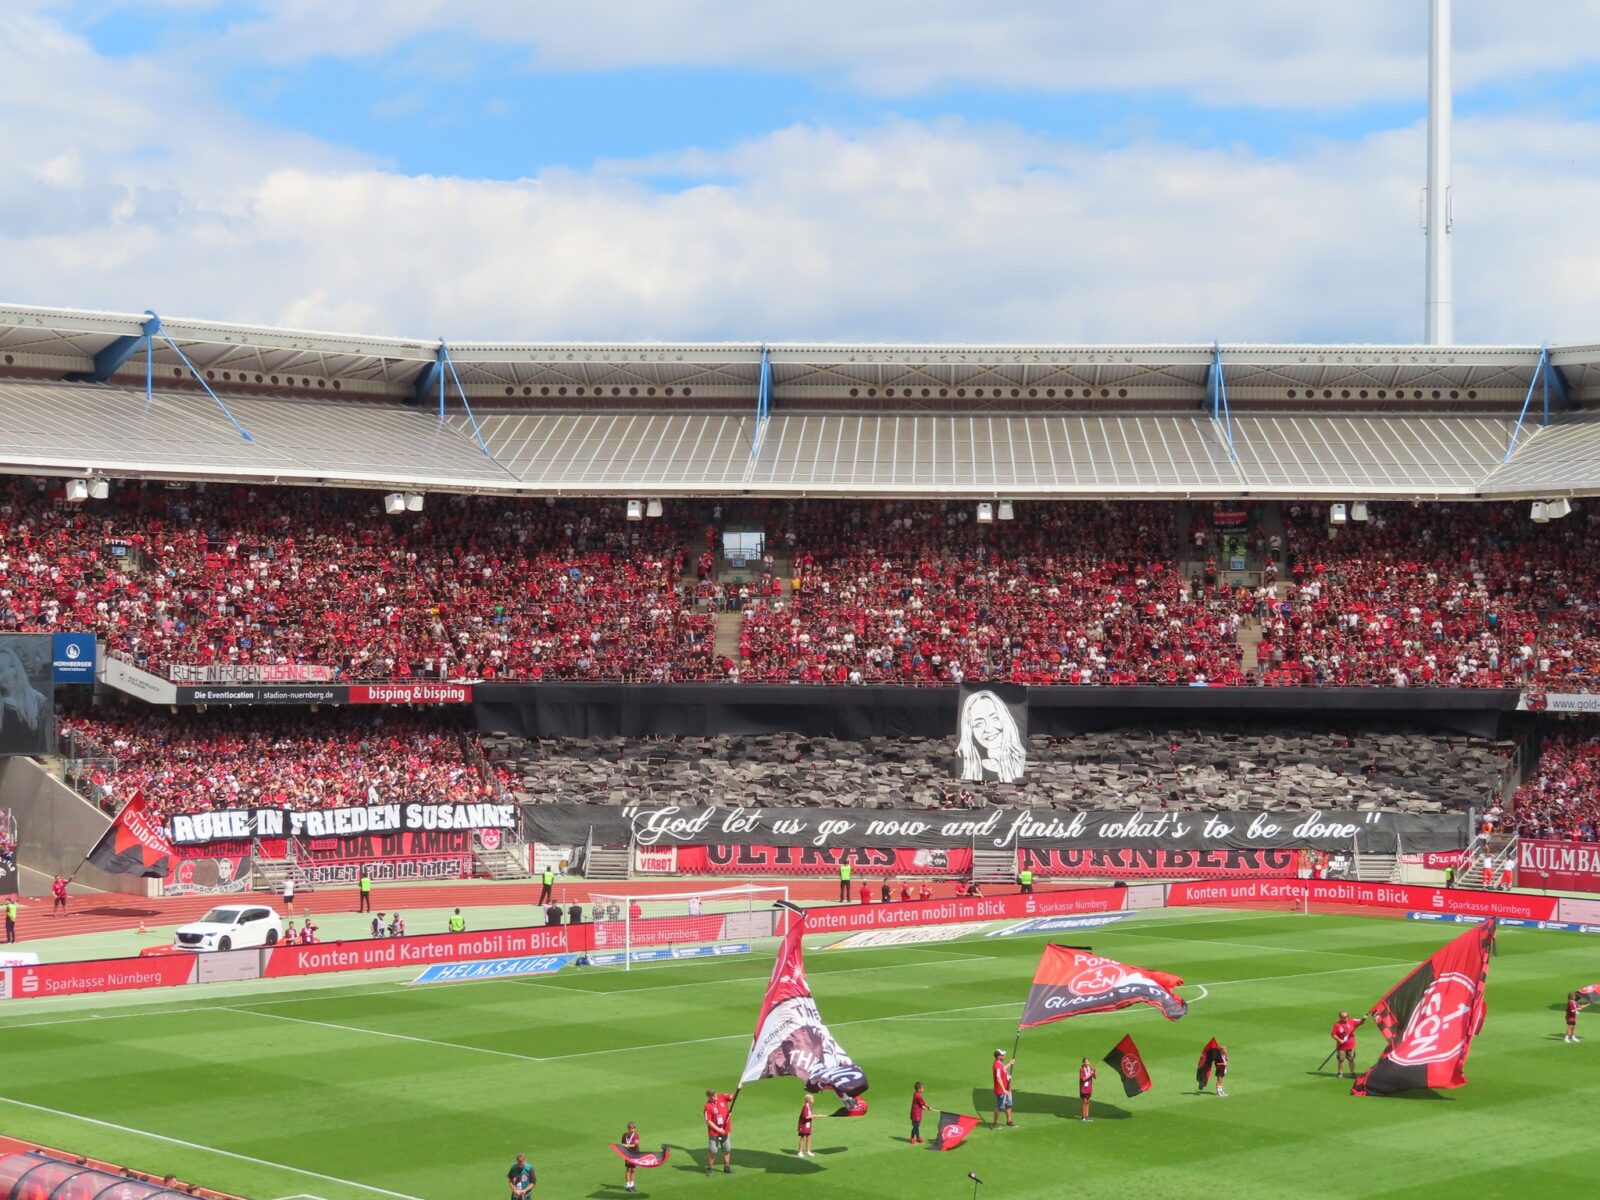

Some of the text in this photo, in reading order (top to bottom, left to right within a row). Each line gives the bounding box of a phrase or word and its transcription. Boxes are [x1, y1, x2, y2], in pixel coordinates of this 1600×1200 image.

[172, 665, 203, 681] RUHE
[206, 665, 218, 680] IN
[219, 664, 261, 680] FRIEDEN
[194, 691, 334, 701] Die Eventlocation stadion-nuernberg.de
[368, 687, 411, 702] bisping
[423, 687, 465, 702] bisping
[1553, 700, 1600, 710] www.gold-
[173, 810, 250, 842] RUHE
[256, 809, 284, 835] IN
[289, 803, 401, 836] FRIEDEN
[406, 803, 516, 830] SUSANNE
[721, 808, 763, 834] let
[772, 820, 807, 835] us
[812, 819, 856, 846] go
[865, 819, 931, 836] now
[941, 809, 1003, 837] and
[993, 809, 1087, 848] finish
[1098, 811, 1191, 839] what's
[1203, 813, 1235, 839] to
[1246, 812, 1283, 840] be
[381, 832, 401, 857] DI
[410, 830, 471, 856] AMICI
[640, 858, 673, 871] VERBOT
[1186, 883, 1409, 904] Konten und Karten mobil im Blick
[850, 909, 874, 925] und
[878, 907, 919, 923] Karten
[922, 904, 957, 919] mobil
[959, 903, 974, 917] im
[977, 901, 1006, 916] Blick
[1039, 903, 1073, 914] Sparkasse
[1075, 900, 1107, 912] Nürnberg
[1448, 900, 1489, 912] Sparkasse
[1490, 902, 1532, 917] Nürnberg
[612, 931, 657, 944] Spakasse
[298, 932, 568, 969] Konten und Karten mobil im Blick
[432, 956, 559, 981] HELMSAUER
[45, 976, 105, 993] Sparkasse
[107, 971, 162, 988] Nürnberg
[1075, 974, 1116, 990] FCN
[1407, 992, 1442, 1059] FCN
